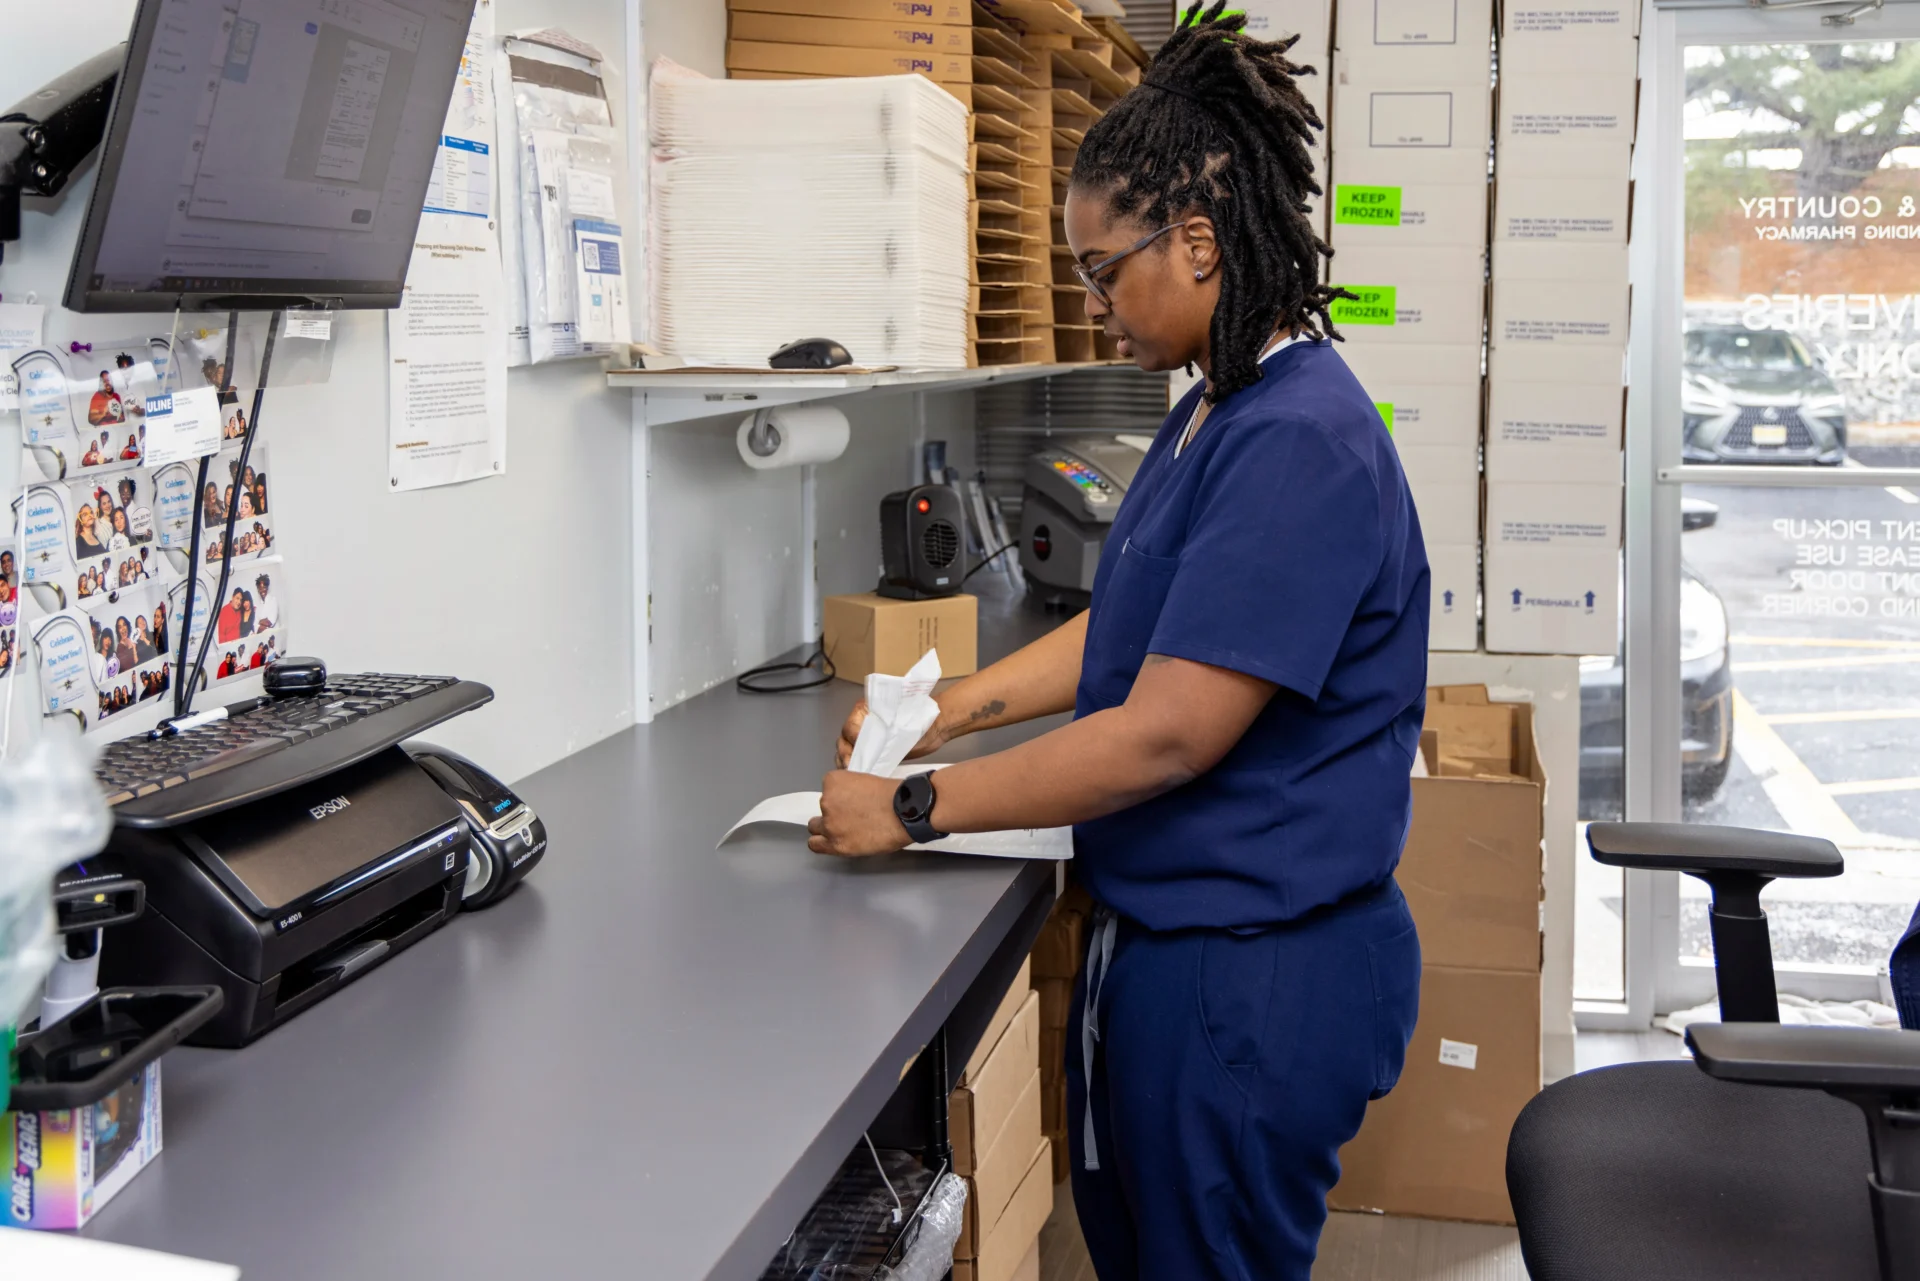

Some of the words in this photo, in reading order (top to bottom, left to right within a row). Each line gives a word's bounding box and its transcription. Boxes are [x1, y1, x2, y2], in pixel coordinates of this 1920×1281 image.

[1351, 193, 1387, 204] KEEP
[1341, 206, 1395, 219] FROZEN
[1346, 293, 1381, 304] EEP
[1337, 306, 1389, 318] FROZEN
[146, 398, 172, 413] ULINE
[1525, 598, 1581, 608] PERISHABLE
[309, 795, 351, 820] EPSON
[494, 799, 512, 813] DYMO
[280, 914, 298, 928] ES-400
[17, 1110, 40, 1170] BEARS
[11, 1167, 32, 1222] CARE
